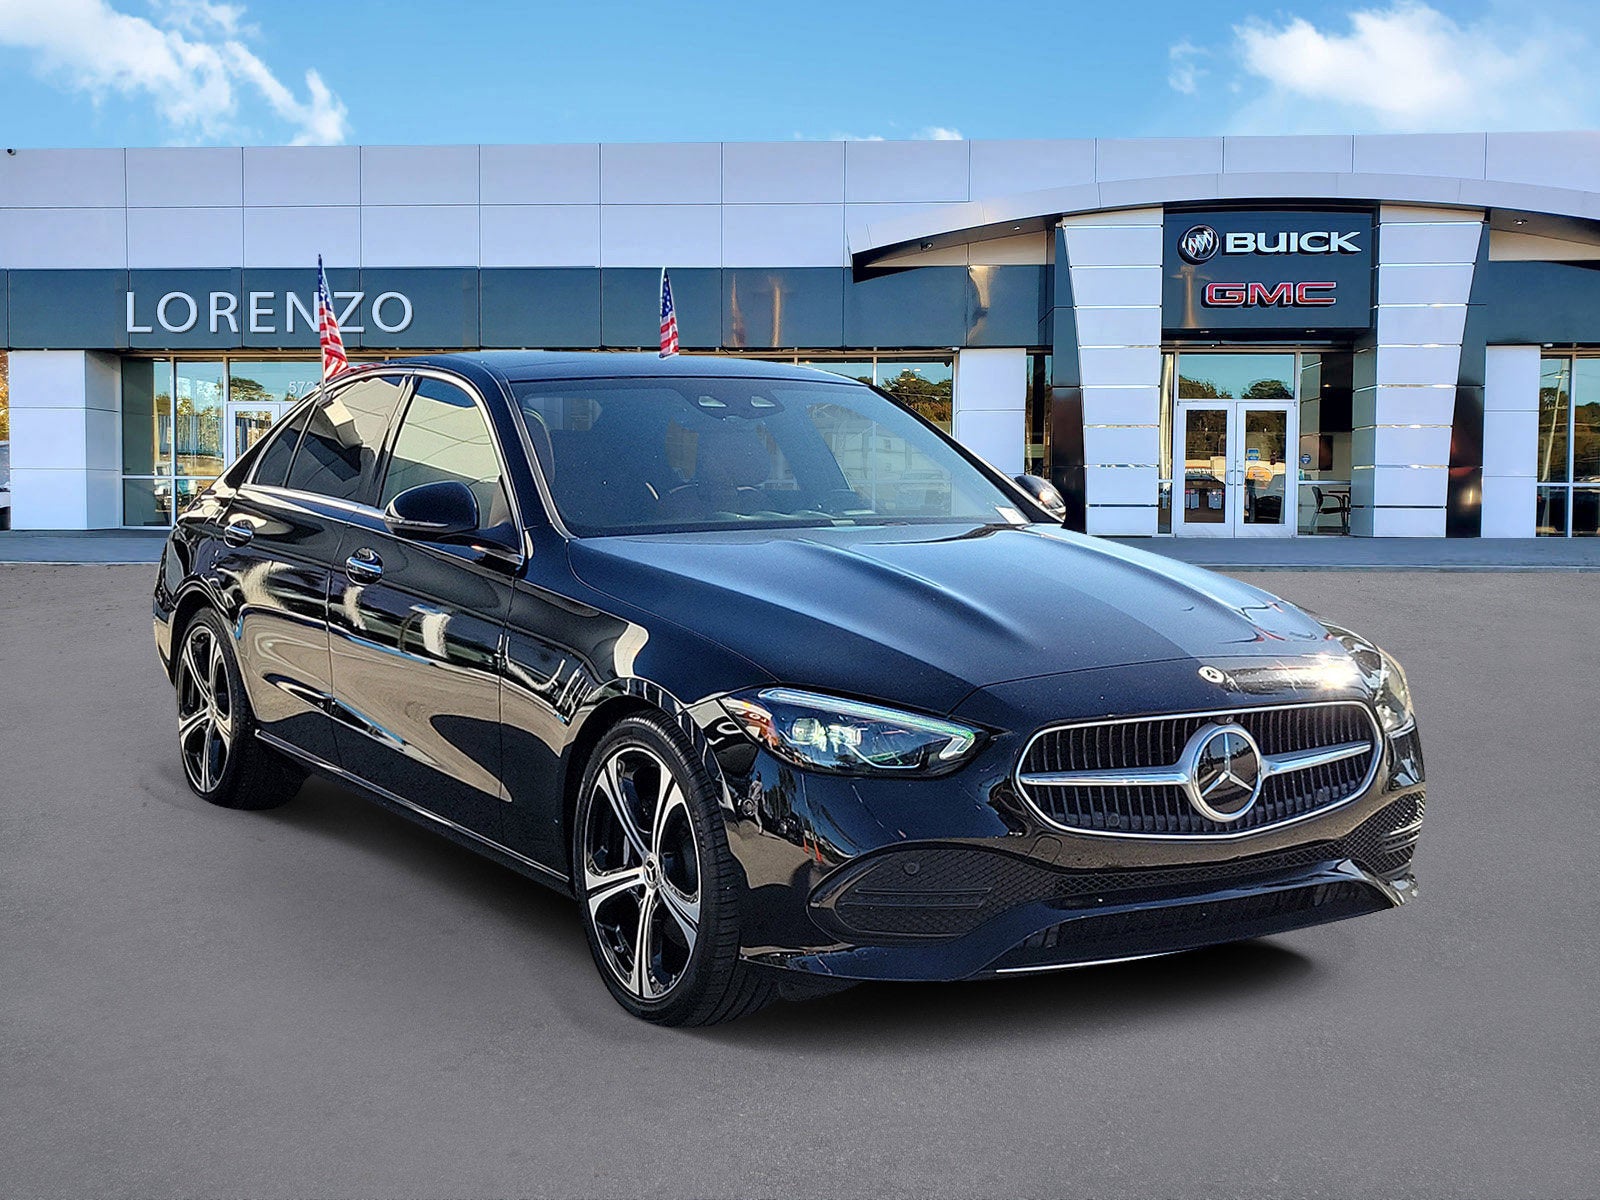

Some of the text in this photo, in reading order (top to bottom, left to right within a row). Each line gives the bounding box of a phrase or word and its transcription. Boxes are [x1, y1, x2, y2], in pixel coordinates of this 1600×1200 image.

[1225, 231, 1362, 253] BUICK
[1204, 281, 1337, 305] GMC
[125, 290, 414, 334] LORENZO
